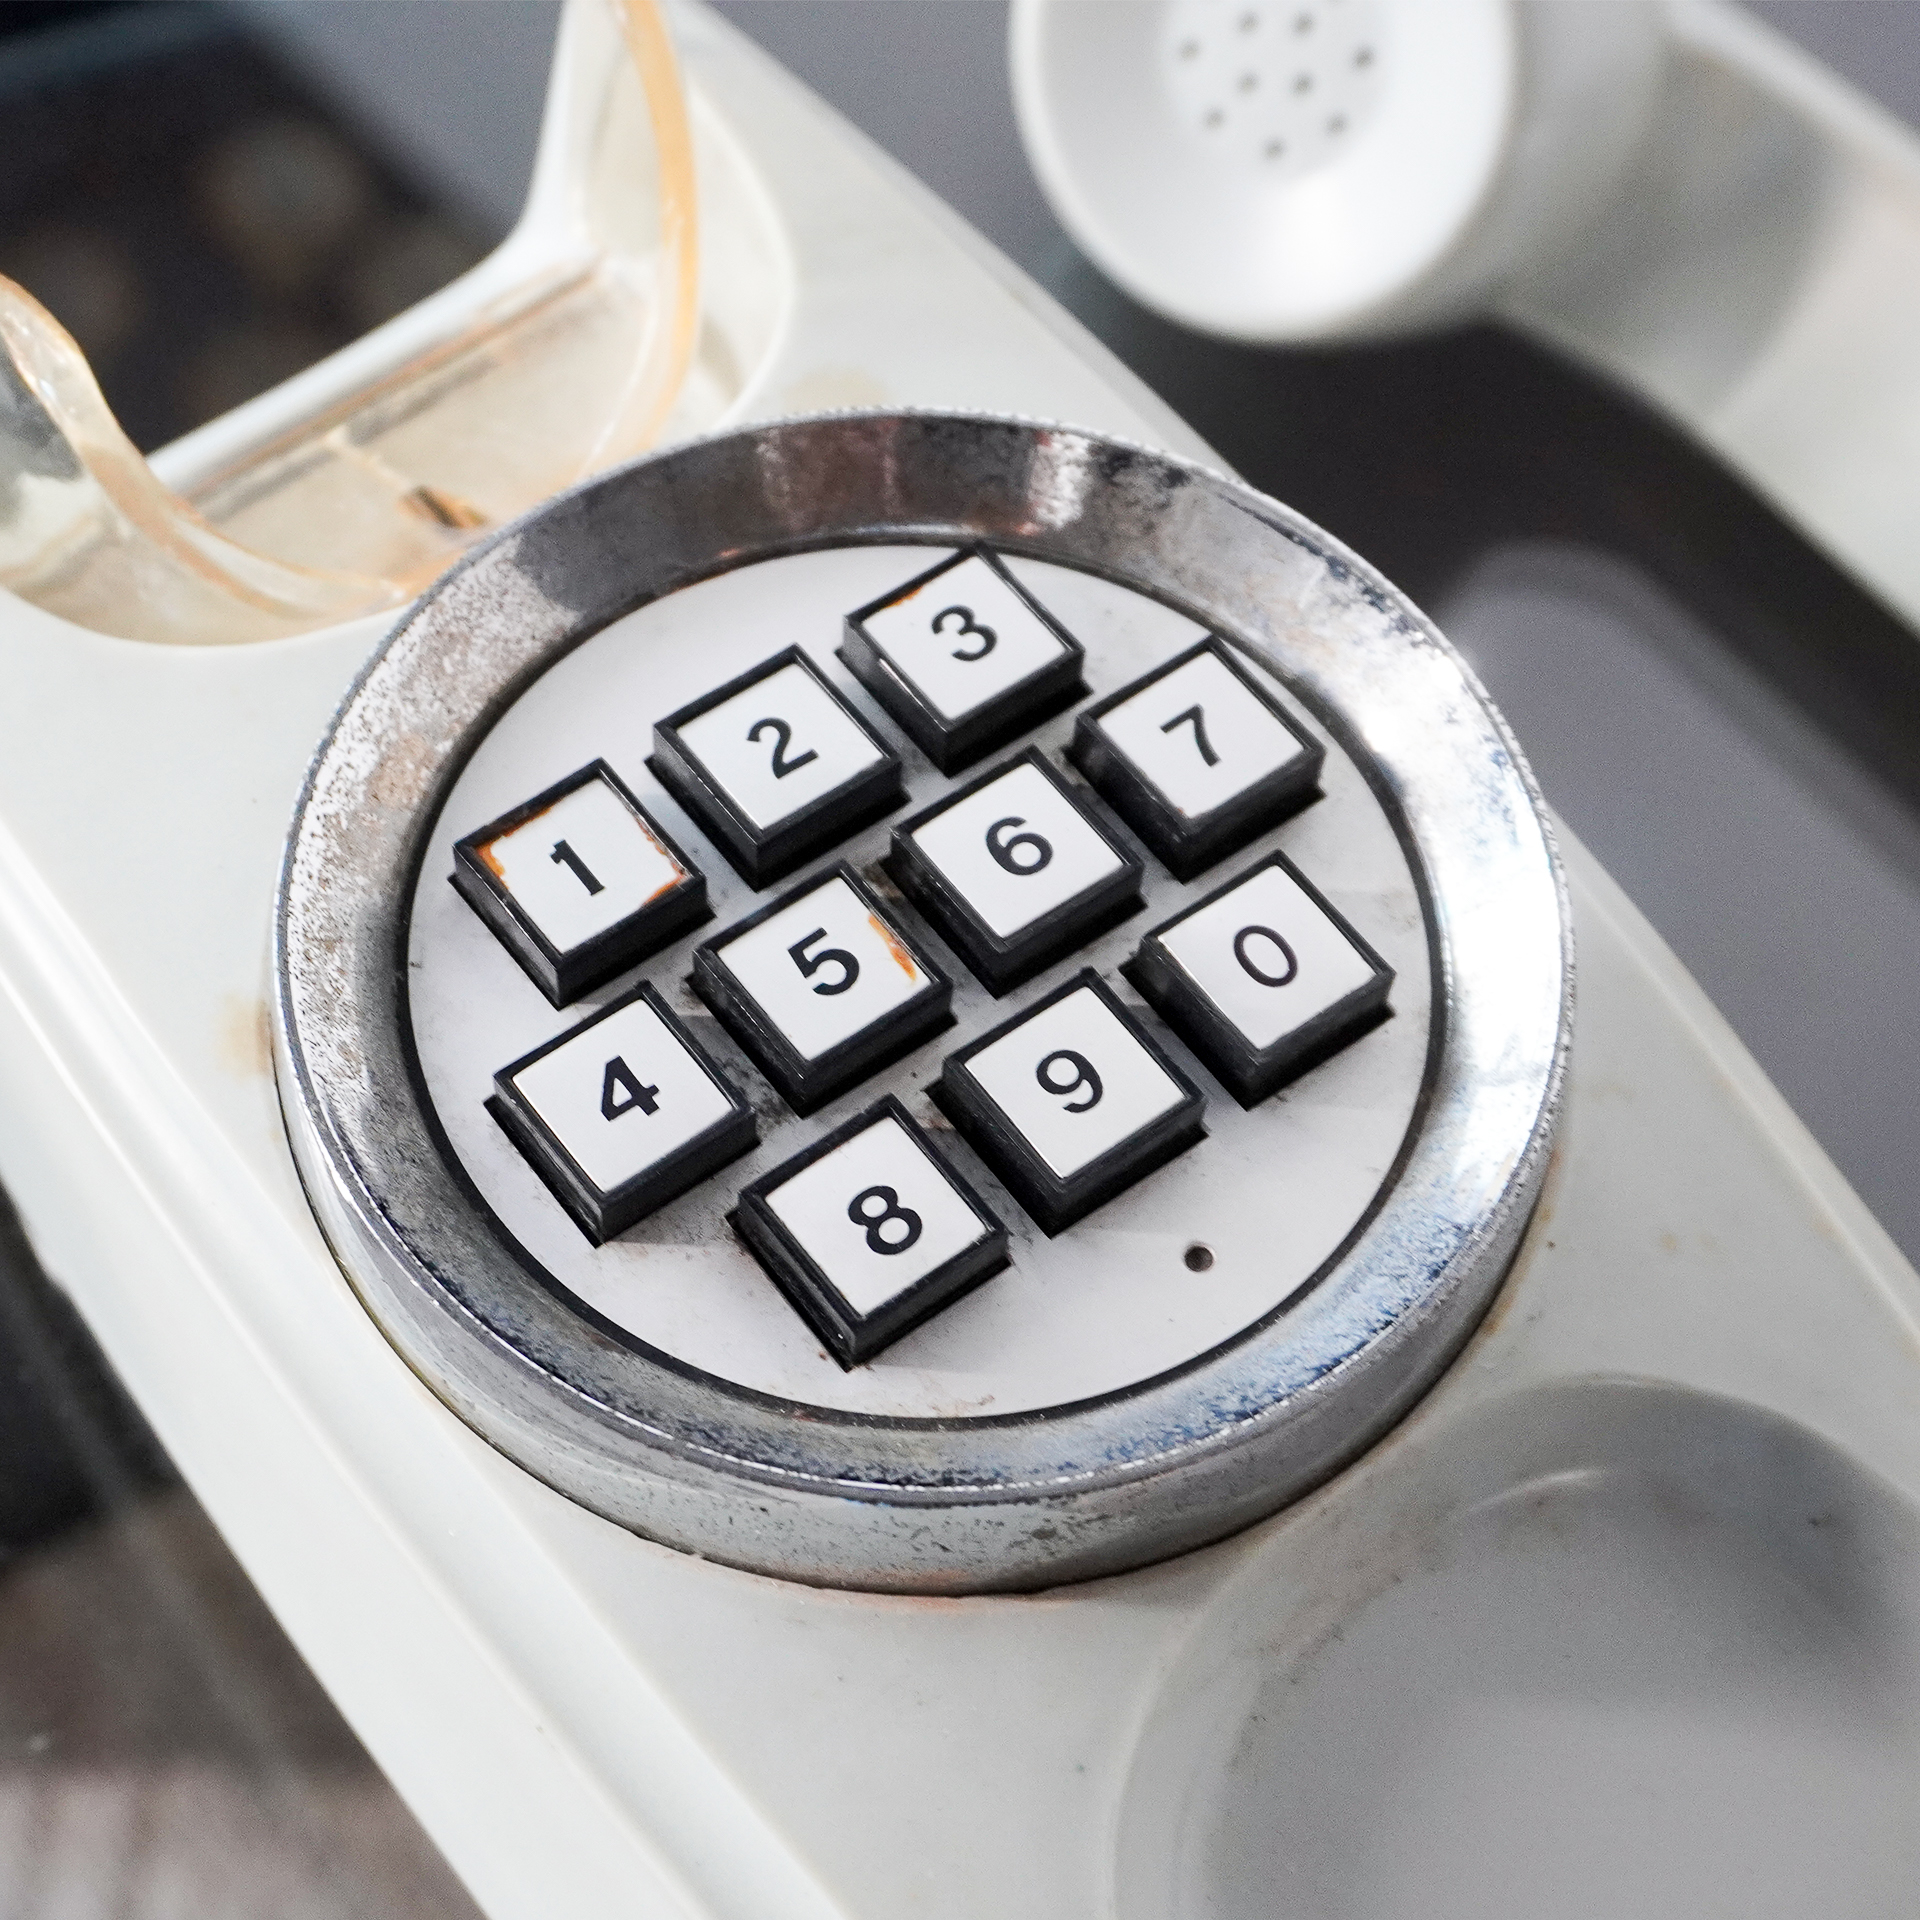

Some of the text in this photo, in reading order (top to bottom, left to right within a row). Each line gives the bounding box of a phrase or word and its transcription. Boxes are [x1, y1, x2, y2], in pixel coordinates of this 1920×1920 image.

[931, 606, 997, 662] 3
[746, 718, 819, 780] 2
[1160, 705, 1219, 767] 7
[550, 839, 605, 897] 1
[985, 817, 1053, 876] 6
[787, 927, 860, 996] 5
[1233, 925, 1298, 988] 0
[600, 1055, 660, 1122] 4
[1035, 1049, 1104, 1114] 9
[847, 1185, 923, 1256] 8
